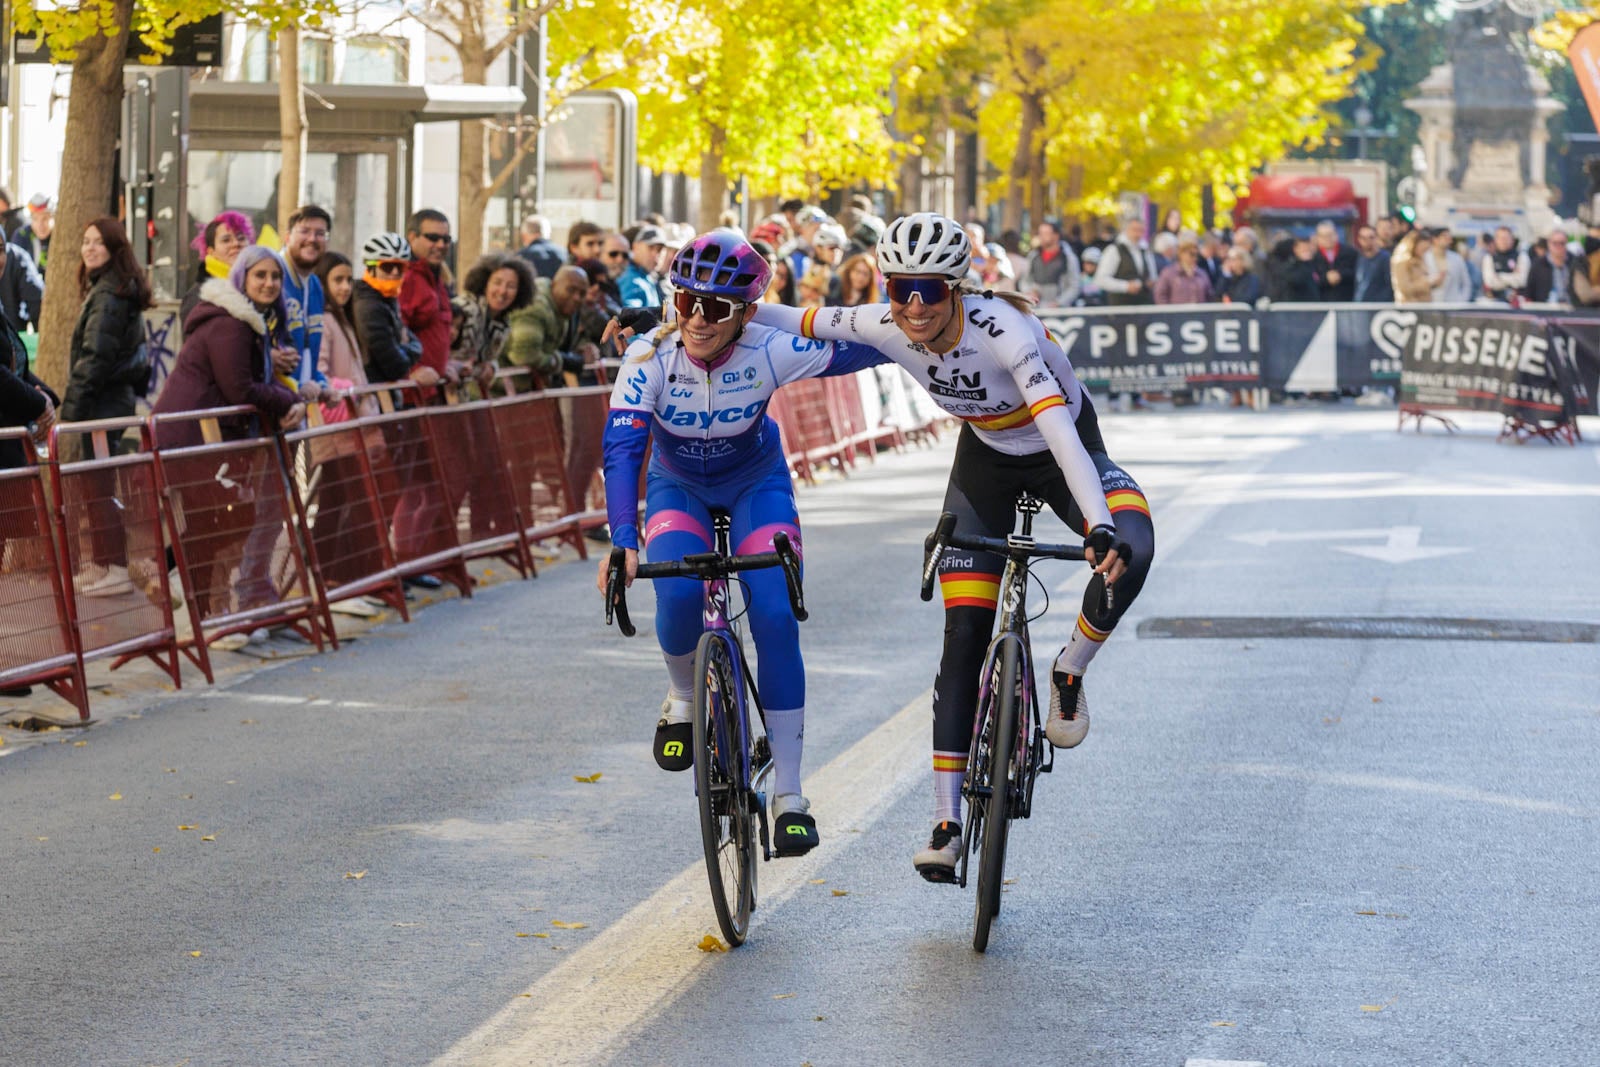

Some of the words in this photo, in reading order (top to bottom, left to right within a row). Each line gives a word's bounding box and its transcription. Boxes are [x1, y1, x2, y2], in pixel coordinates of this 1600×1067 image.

[968, 308, 1006, 338] Liv
[1090, 319, 1260, 358] PISSEI
[624, 367, 648, 405] Liv
[928, 364, 981, 389] Liv
[670, 387, 693, 398] Liv
[939, 387, 980, 400] RACING
[654, 400, 766, 430] Jayco
